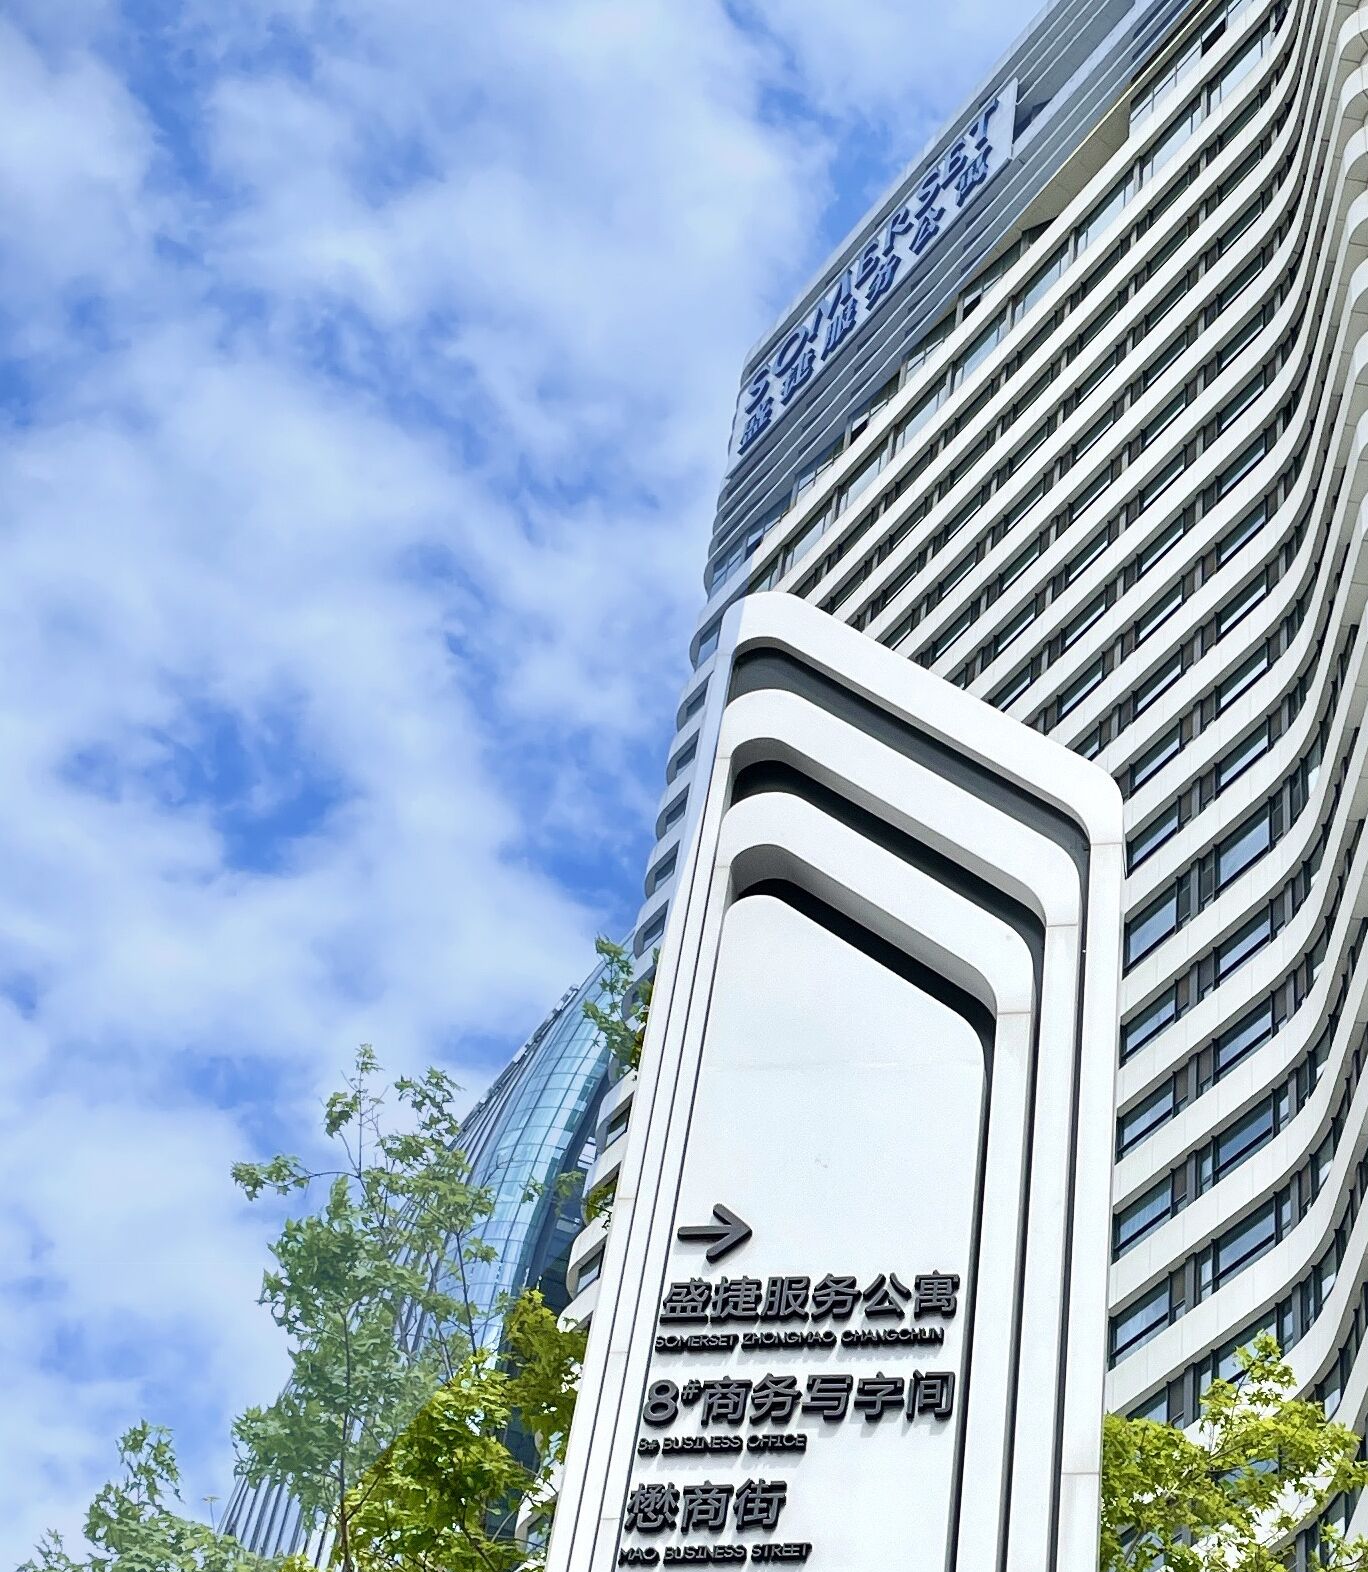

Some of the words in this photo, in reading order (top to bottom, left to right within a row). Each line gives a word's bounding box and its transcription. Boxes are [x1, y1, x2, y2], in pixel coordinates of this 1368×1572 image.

[745, 98, 1000, 415] SOMERSET
[660, 1270, 960, 1324] 盛捷服务公寓
[655, 1333, 739, 1353] SOMERSET
[741, 1330, 837, 1352] ZHONGMAO
[841, 1327, 944, 1349] CHANGCHUN
[643, 1369, 955, 1427] 8#商务写字间
[637, 1438, 660, 1458] 8#
[662, 1435, 743, 1456] BUSINESS
[747, 1434, 807, 1454] OFFICE
[624, 1478, 787, 1535] 懋商街
[618, 1547, 660, 1567] MAO
[663, 1544, 747, 1566] BUSINESS
[751, 1543, 812, 1563] STREET
